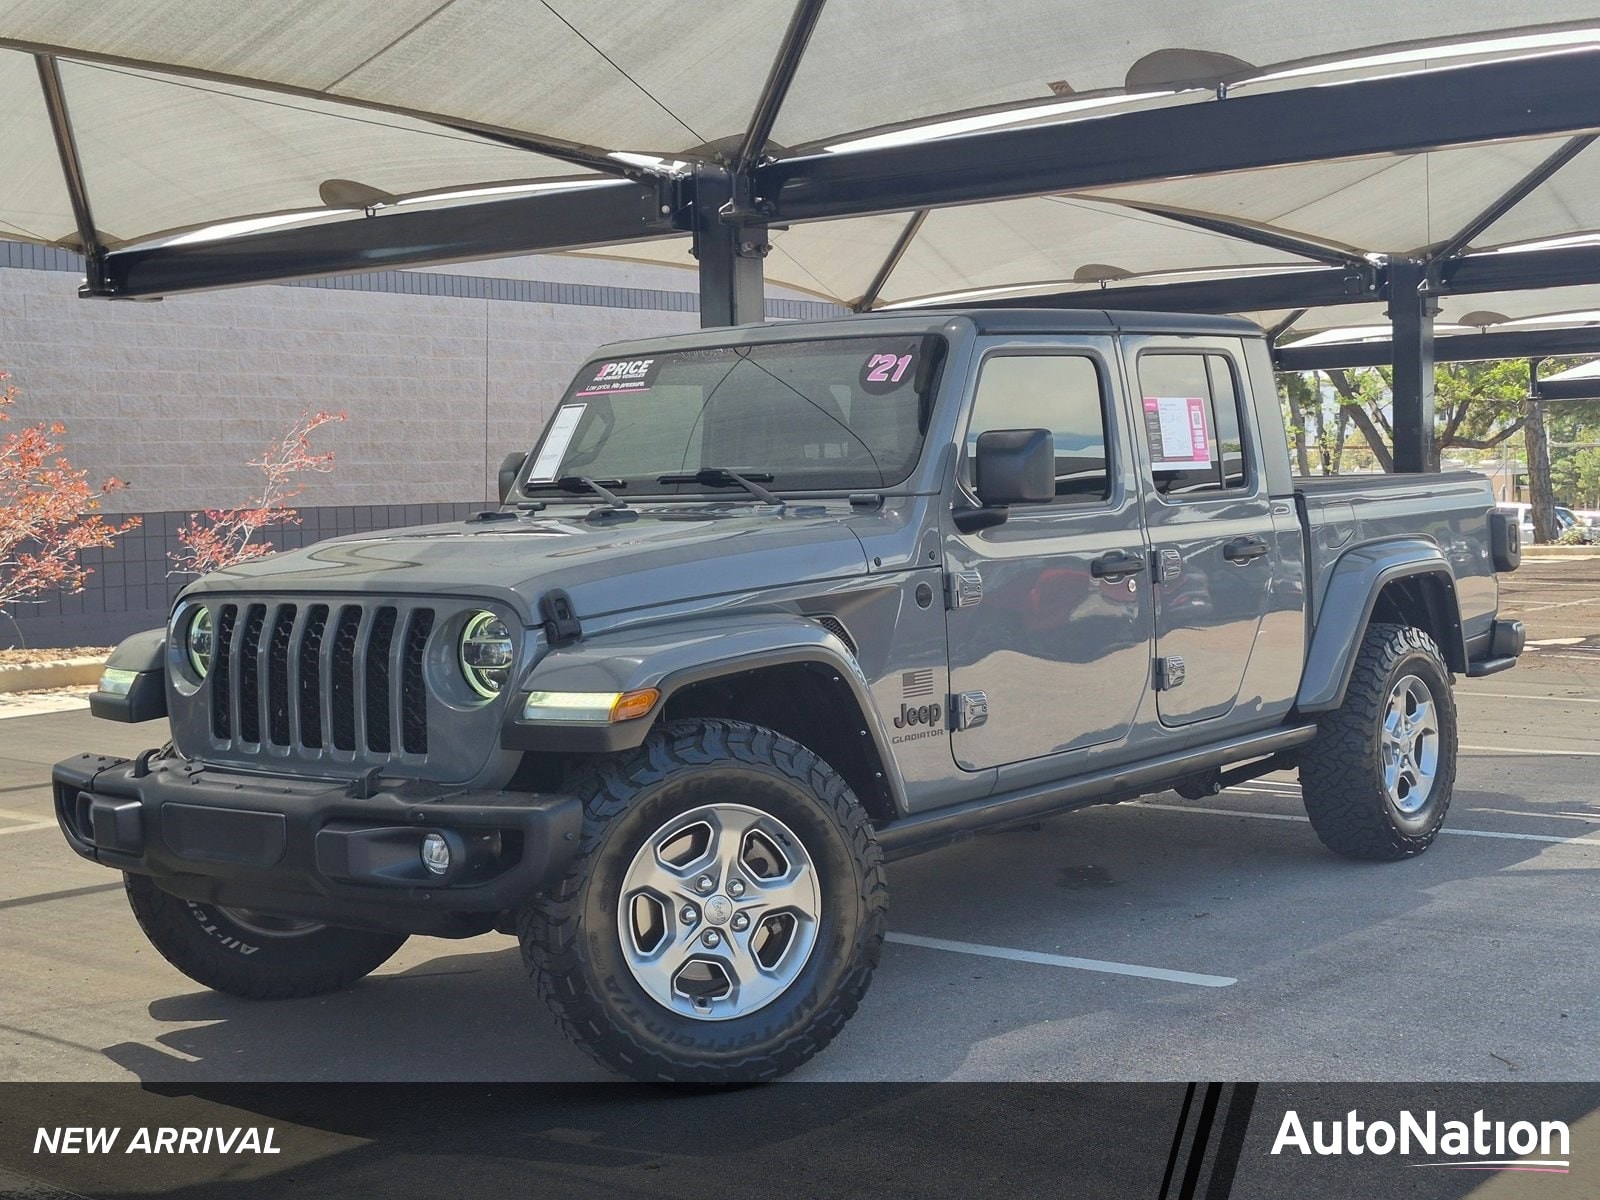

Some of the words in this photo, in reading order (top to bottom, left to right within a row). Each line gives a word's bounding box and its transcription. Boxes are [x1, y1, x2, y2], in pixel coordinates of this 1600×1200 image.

[866, 353, 913, 382] '21
[893, 702, 942, 729] Jeep
[891, 728, 944, 745] GLADIATOR
